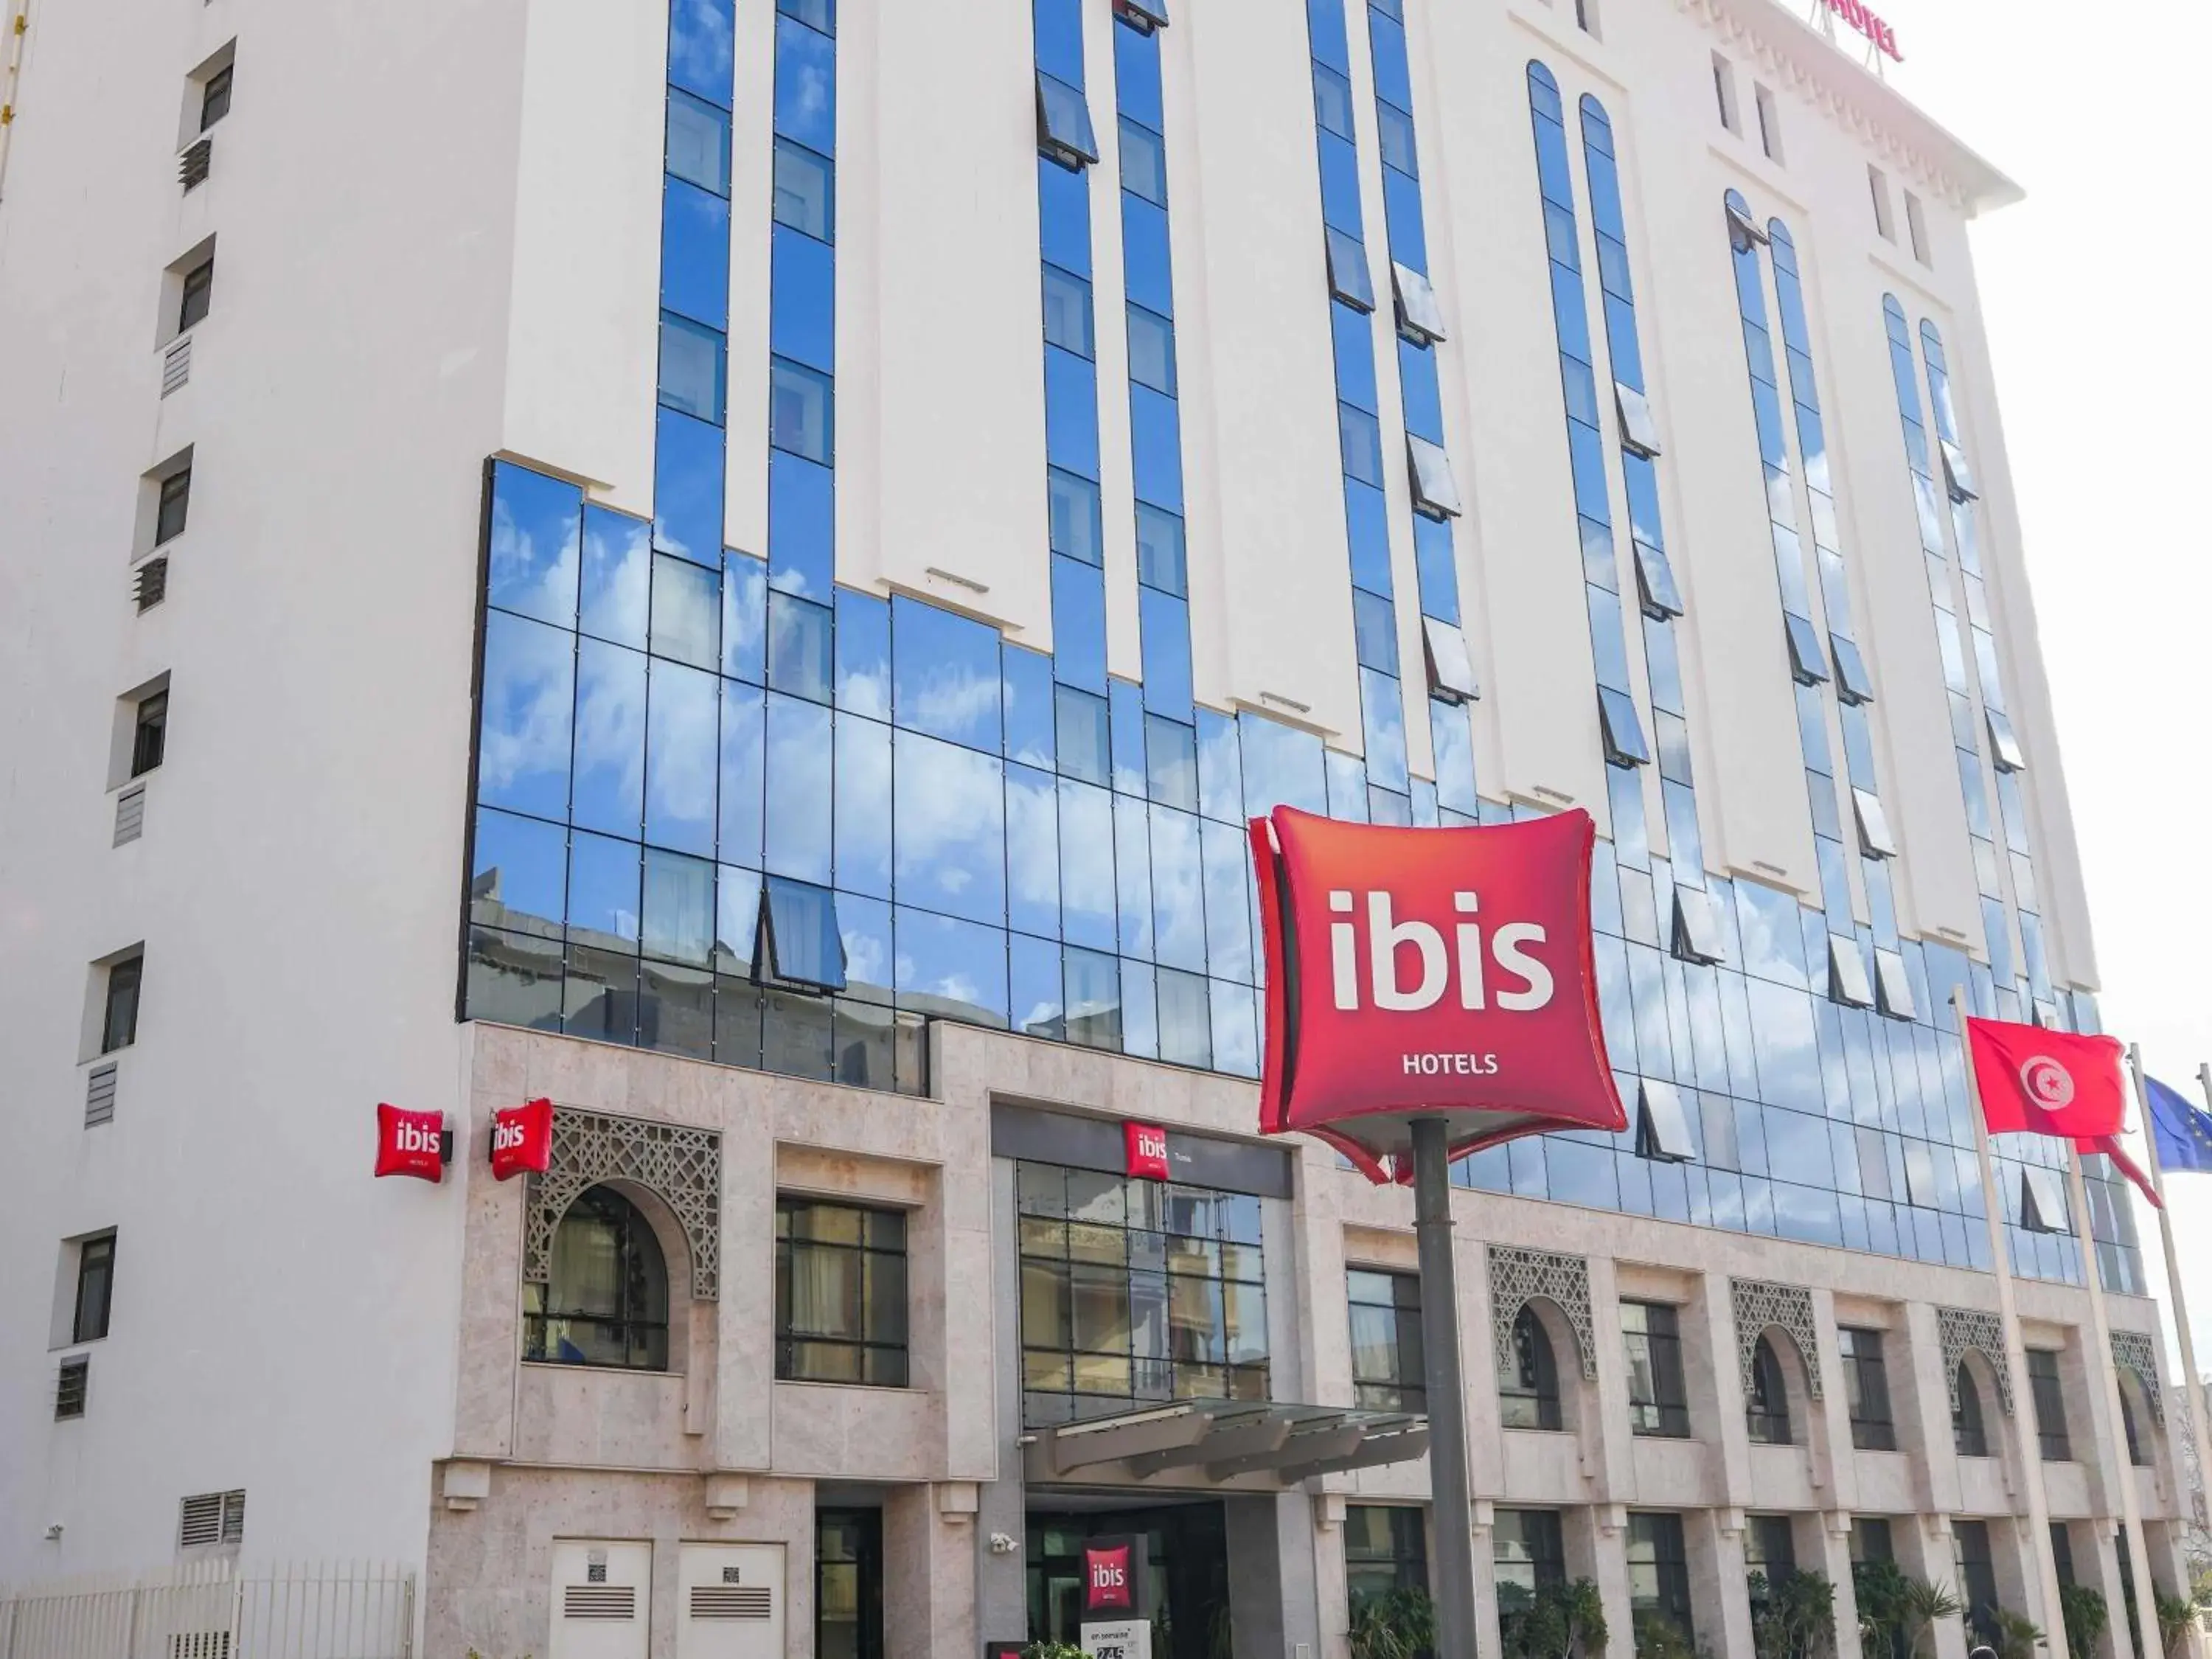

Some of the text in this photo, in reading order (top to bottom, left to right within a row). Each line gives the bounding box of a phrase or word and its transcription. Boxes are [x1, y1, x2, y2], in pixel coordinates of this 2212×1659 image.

[1329, 891, 1554, 1011] ibis
[1403, 1054, 1498, 1074] HOTELS
[397, 1121, 440, 1153] ibis
[494, 1119, 524, 1150] ibis
[1138, 1133, 1166, 1159] ibis
[1093, 1563, 1124, 1587] ibis
